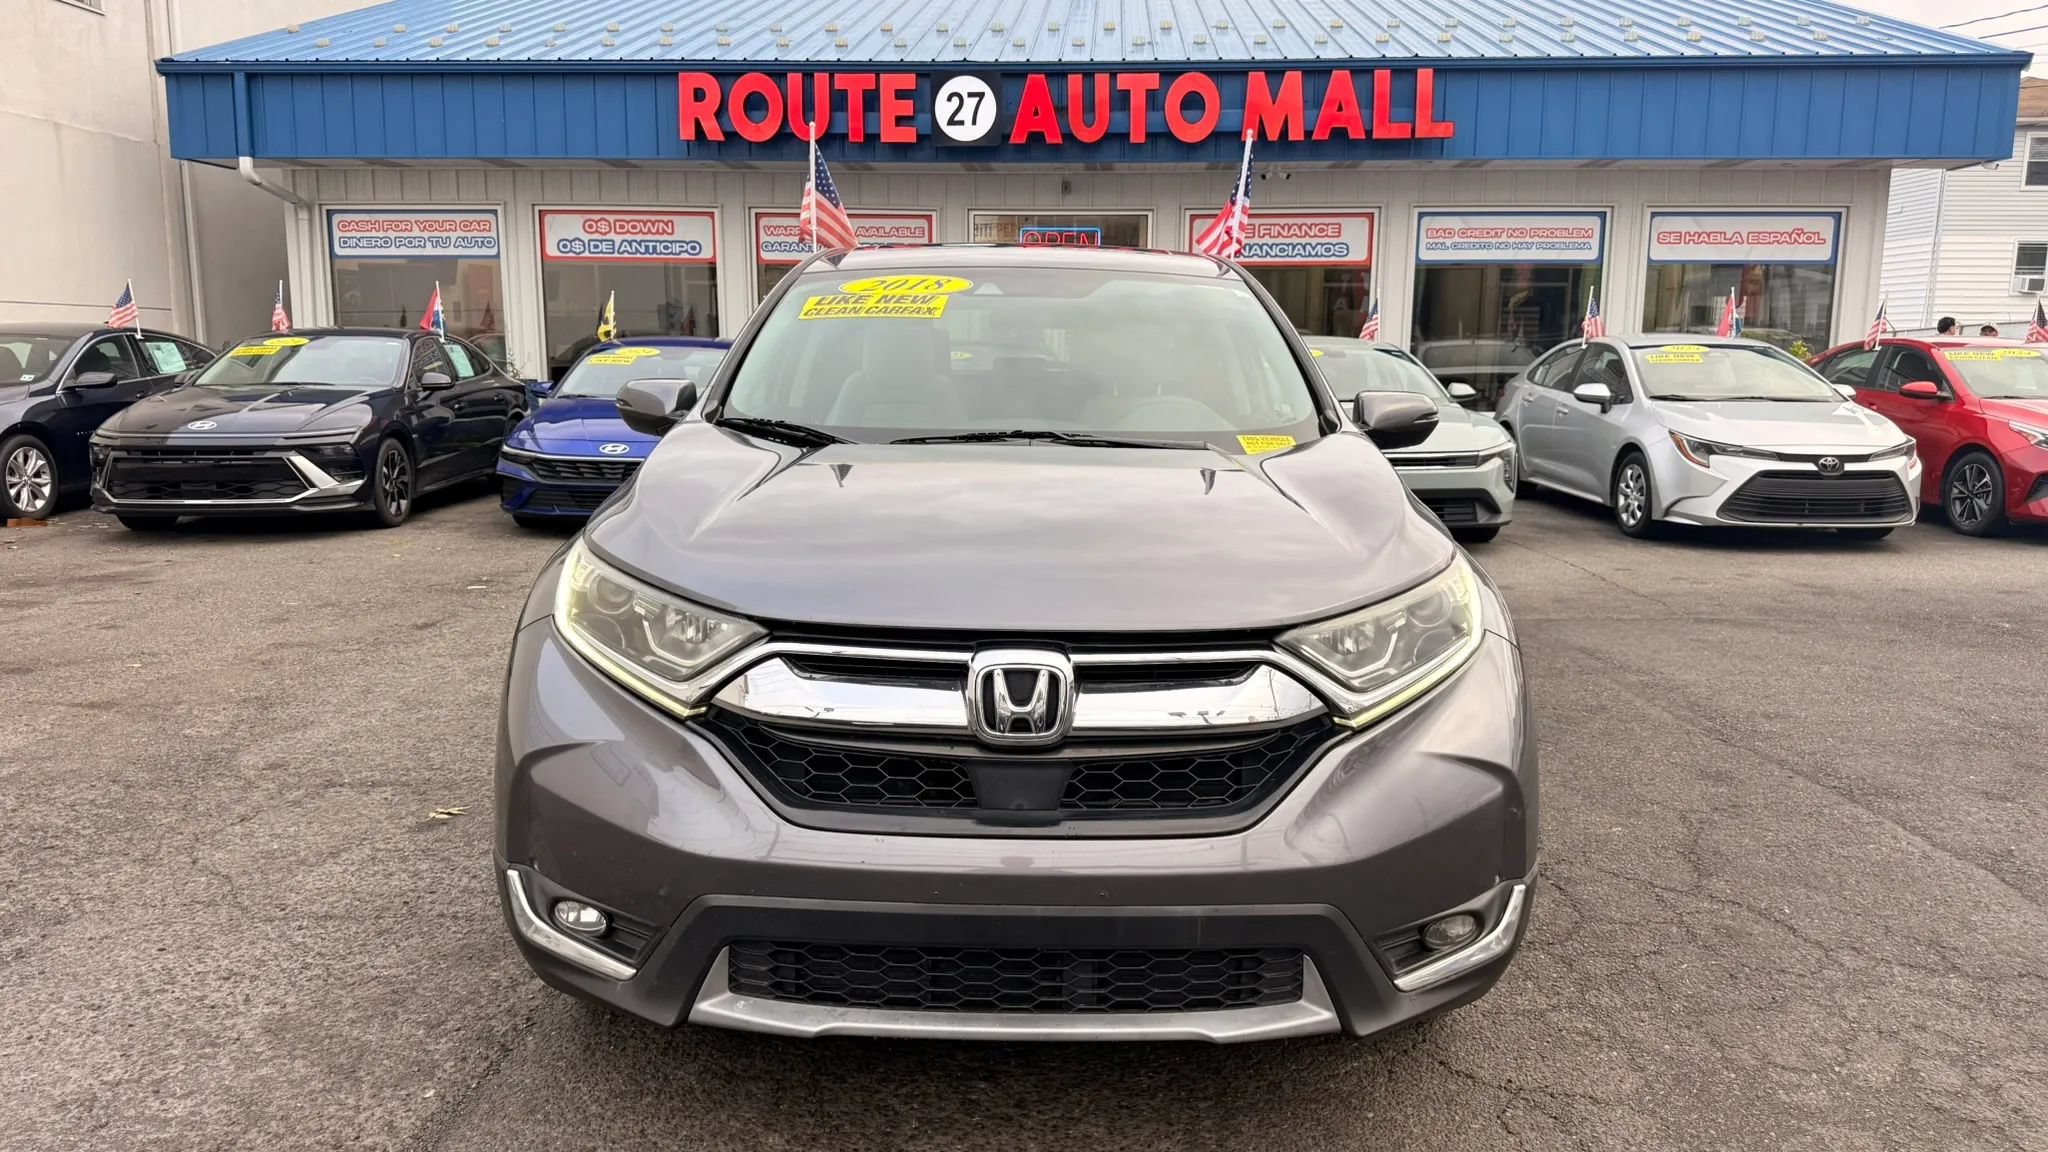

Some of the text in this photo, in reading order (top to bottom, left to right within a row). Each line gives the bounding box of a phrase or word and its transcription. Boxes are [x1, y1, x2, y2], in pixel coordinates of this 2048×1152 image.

[678, 68, 1455, 144] ROUTE 27 AUTO MALL
[338, 220, 492, 232] CASH FOR YOUR CAR
[614, 219, 674, 235] DOWN
[855, 226, 925, 238] AVAILABLE
[1257, 223, 1341, 239] FINANCE
[1426, 228, 1593, 239] BAD CREDIT NO PROBLEM
[1657, 228, 1826, 245] SE HABLA ESPAÑOL
[339, 236, 496, 248] DINERO POR TU AUTO
[588, 239, 615, 254] DE
[617, 240, 702, 255] ANTICIPO
[1426, 242, 1449, 251] MAL
[1495, 242, 1511, 251] NO
[1511, 242, 1535, 251] HAY
[1535, 242, 1592, 251] PROBLEMA
[860, 278, 951, 292] 2018
[813, 295, 938, 306] LIKE NEW
[804, 306, 942, 317] CLEAN CARFAX
